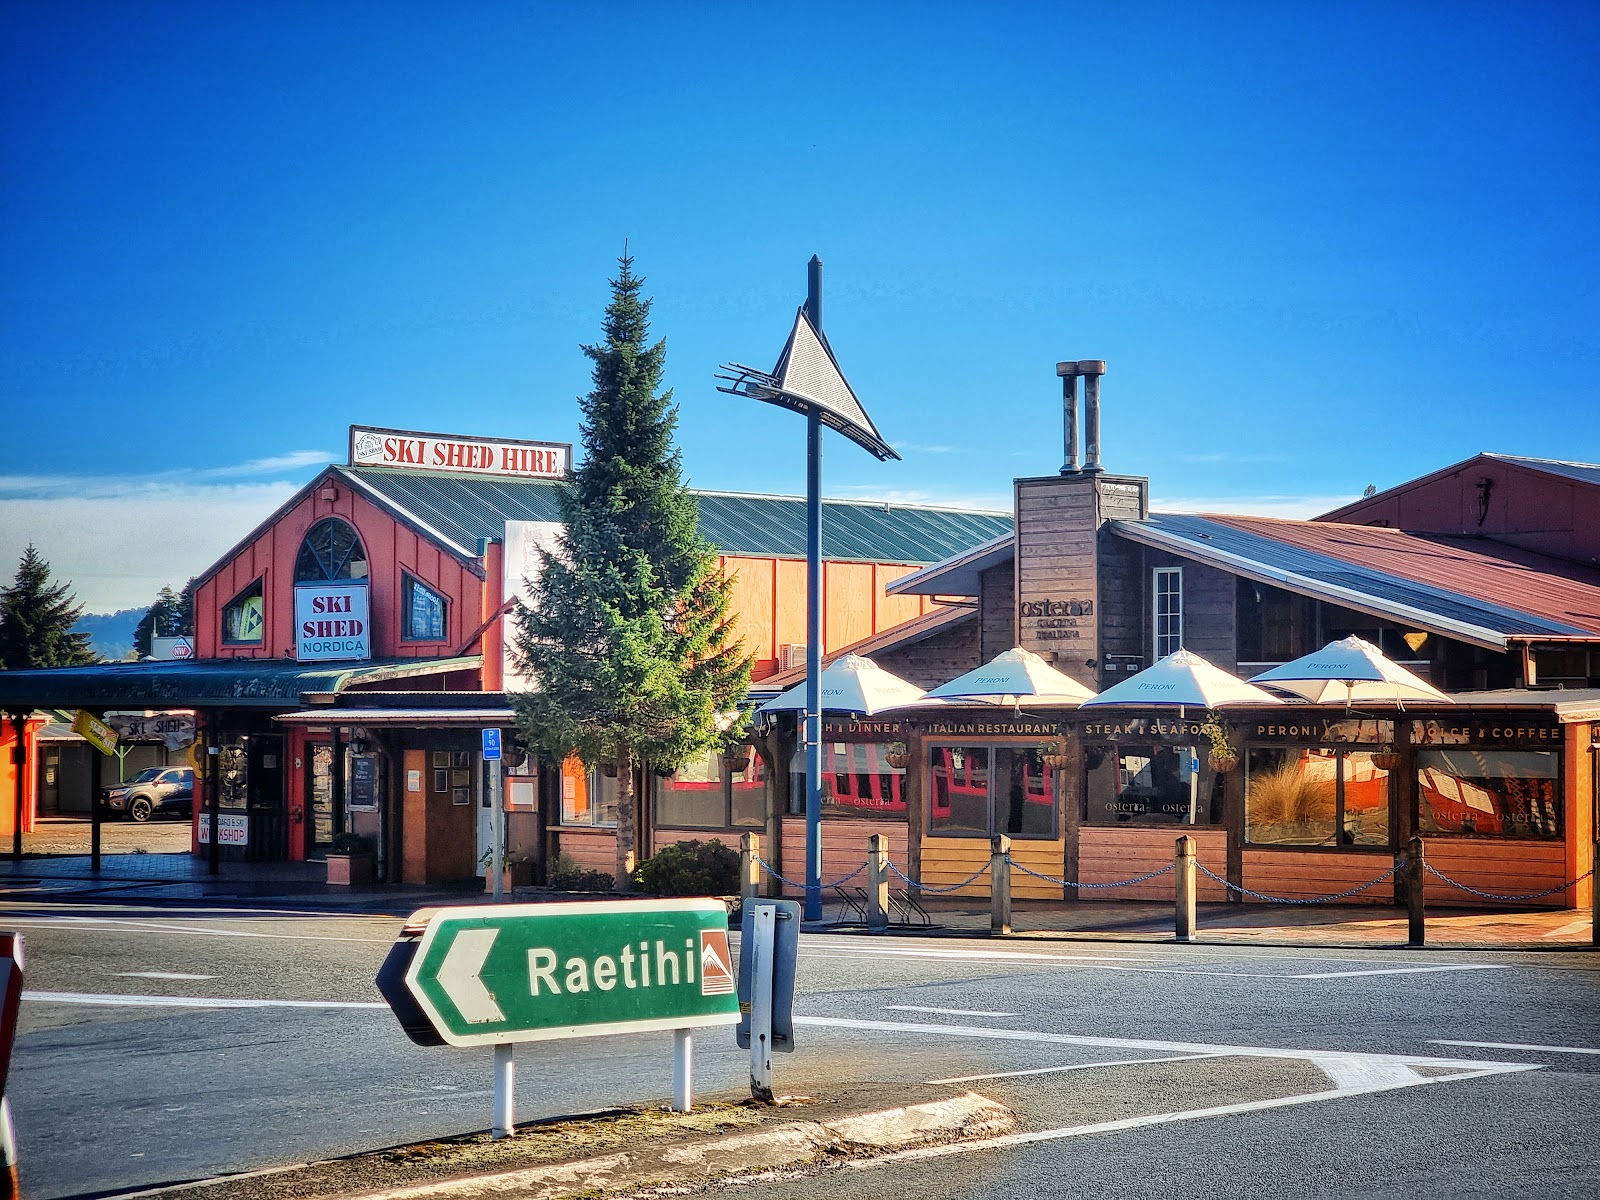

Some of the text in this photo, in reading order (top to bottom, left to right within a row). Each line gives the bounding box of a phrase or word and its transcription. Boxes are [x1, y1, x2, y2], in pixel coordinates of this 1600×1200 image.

[383, 437, 427, 464] SKI
[432, 442, 494, 469] SHED
[501, 447, 558, 473] HIRE
[312, 596, 352, 614] SKI
[303, 620, 364, 639] SHED
[303, 641, 365, 653] NORDICA
[1138, 682, 1176, 690] PERONI
[128, 719, 180, 736] SKI SHED
[848, 723, 900, 733] DINNER
[928, 723, 1058, 734] ITALIAN RESTAURANT
[1085, 724, 1132, 735] STEAK
[1257, 725, 1318, 736] PERONI
[1491, 727, 1560, 739] COFFEE
[488, 730, 495, 739] P
[488, 739, 496, 747] 90
[1162, 803, 1204, 814] ostera
[200, 827, 245, 842] WKSHOP
[526, 938, 696, 997] Raetihi
